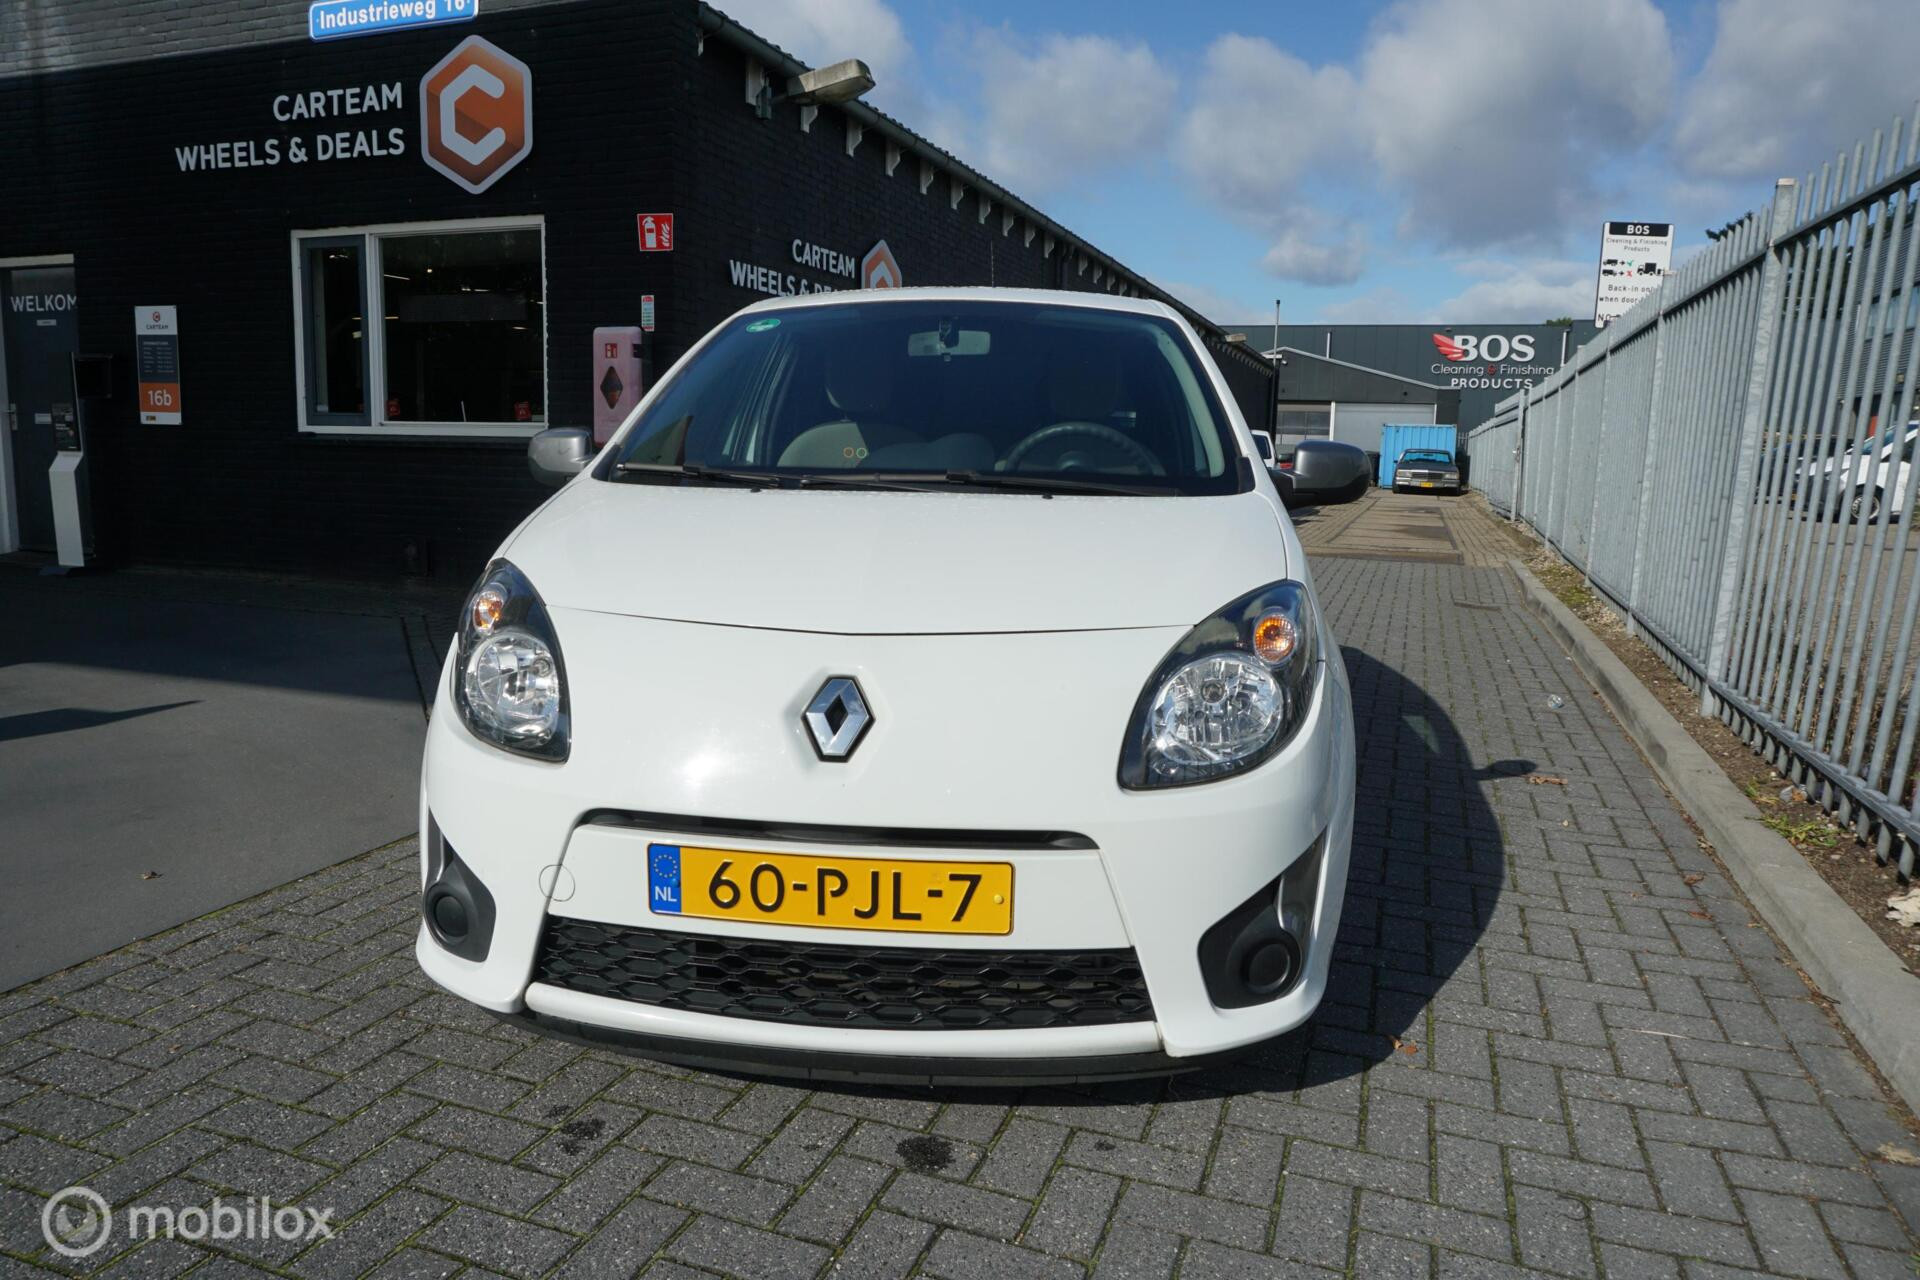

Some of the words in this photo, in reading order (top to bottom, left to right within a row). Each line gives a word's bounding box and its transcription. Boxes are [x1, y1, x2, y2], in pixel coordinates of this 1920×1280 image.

[320, 0, 436, 29] Industrieweg
[272, 82, 403, 121] CARTEAM
[175, 138, 279, 171] WHEELS
[288, 137, 309, 163] &
[317, 128, 405, 161] DEALS
[1627, 225, 1650, 235] BOS
[792, 239, 855, 279] CARTEAM
[729, 259, 796, 297] WHEELS
[1608, 284, 1638, 292] Back-in
[1453, 335, 1535, 362] BOS
[1431, 363, 1484, 376] Cleaning
[1500, 364, 1554, 375] Finishing
[1451, 378, 1533, 389] PRODUCTS
[148, 389, 172, 406] 16b
[655, 885, 677, 902] NL
[708, 860, 983, 922] 60-PJL-7
